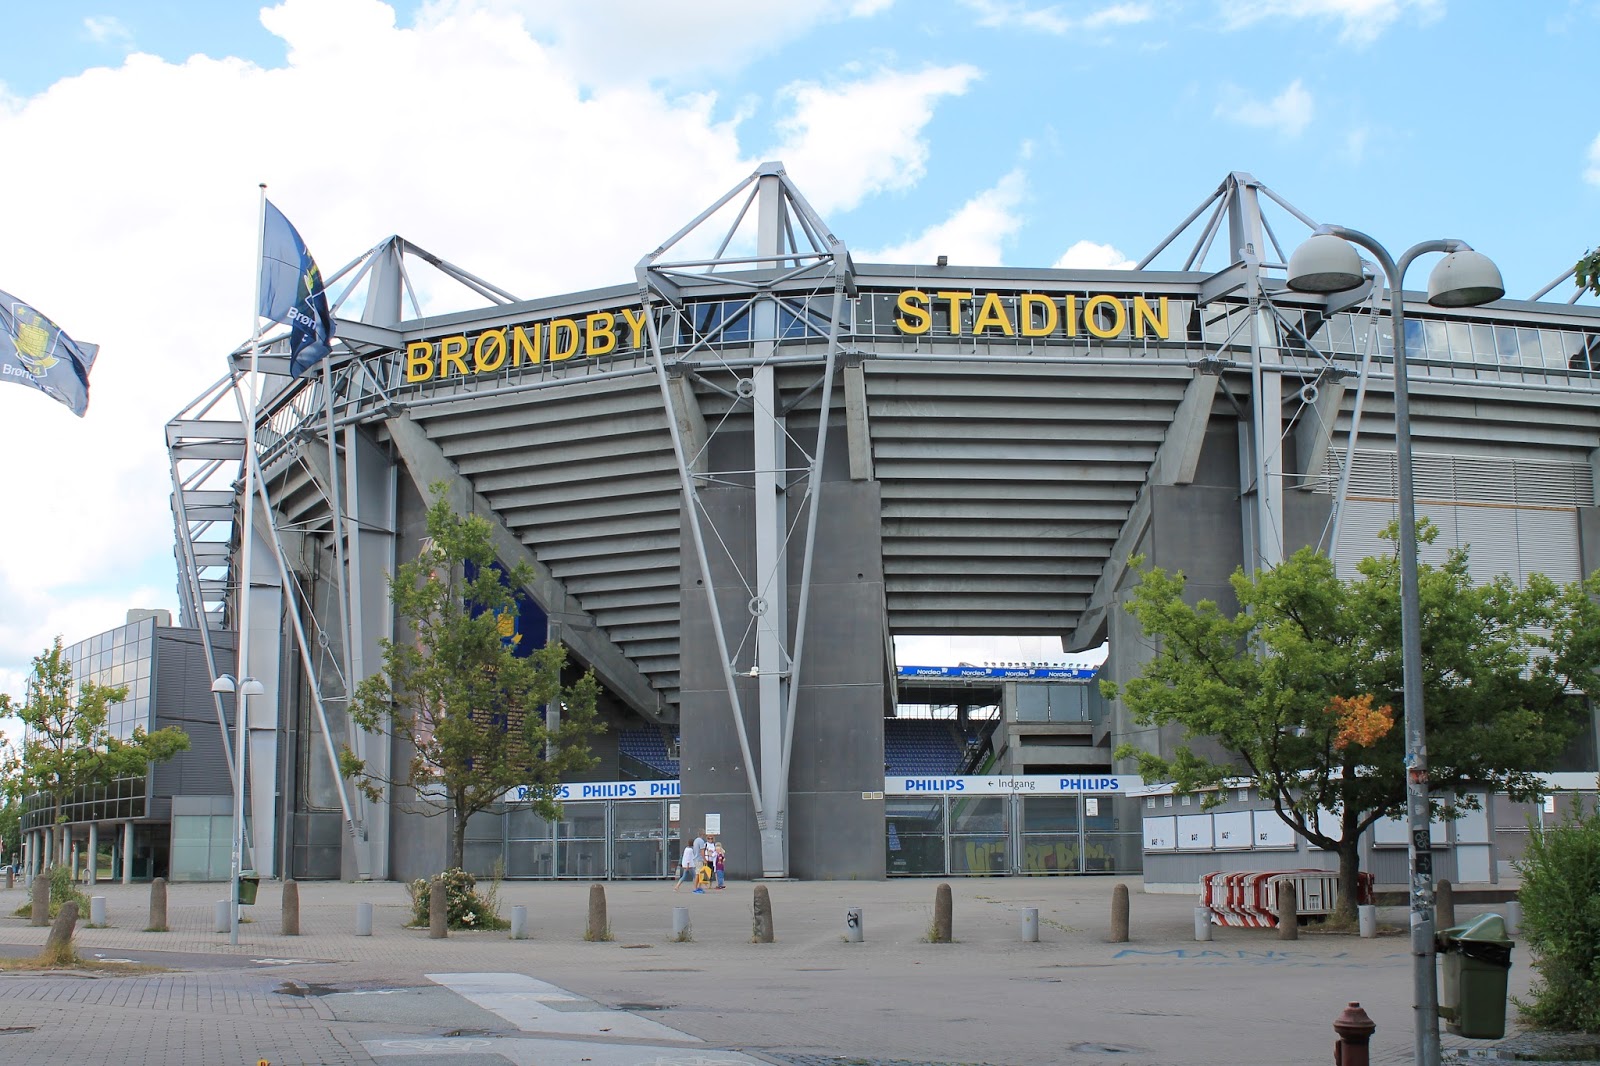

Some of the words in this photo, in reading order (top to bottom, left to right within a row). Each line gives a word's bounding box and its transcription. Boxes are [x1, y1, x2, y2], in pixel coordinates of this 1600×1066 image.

[286, 306, 317, 330] Brøn
[406, 305, 653, 383] BRØNDBY
[896, 289, 1170, 340] STADION
[582, 783, 637, 798] PHILIPS
[650, 783, 680, 796] PHIL
[905, 779, 965, 791] PHILIPS
[998, 779, 1036, 790] Indgang
[1059, 778, 1119, 790] PHILIPS
